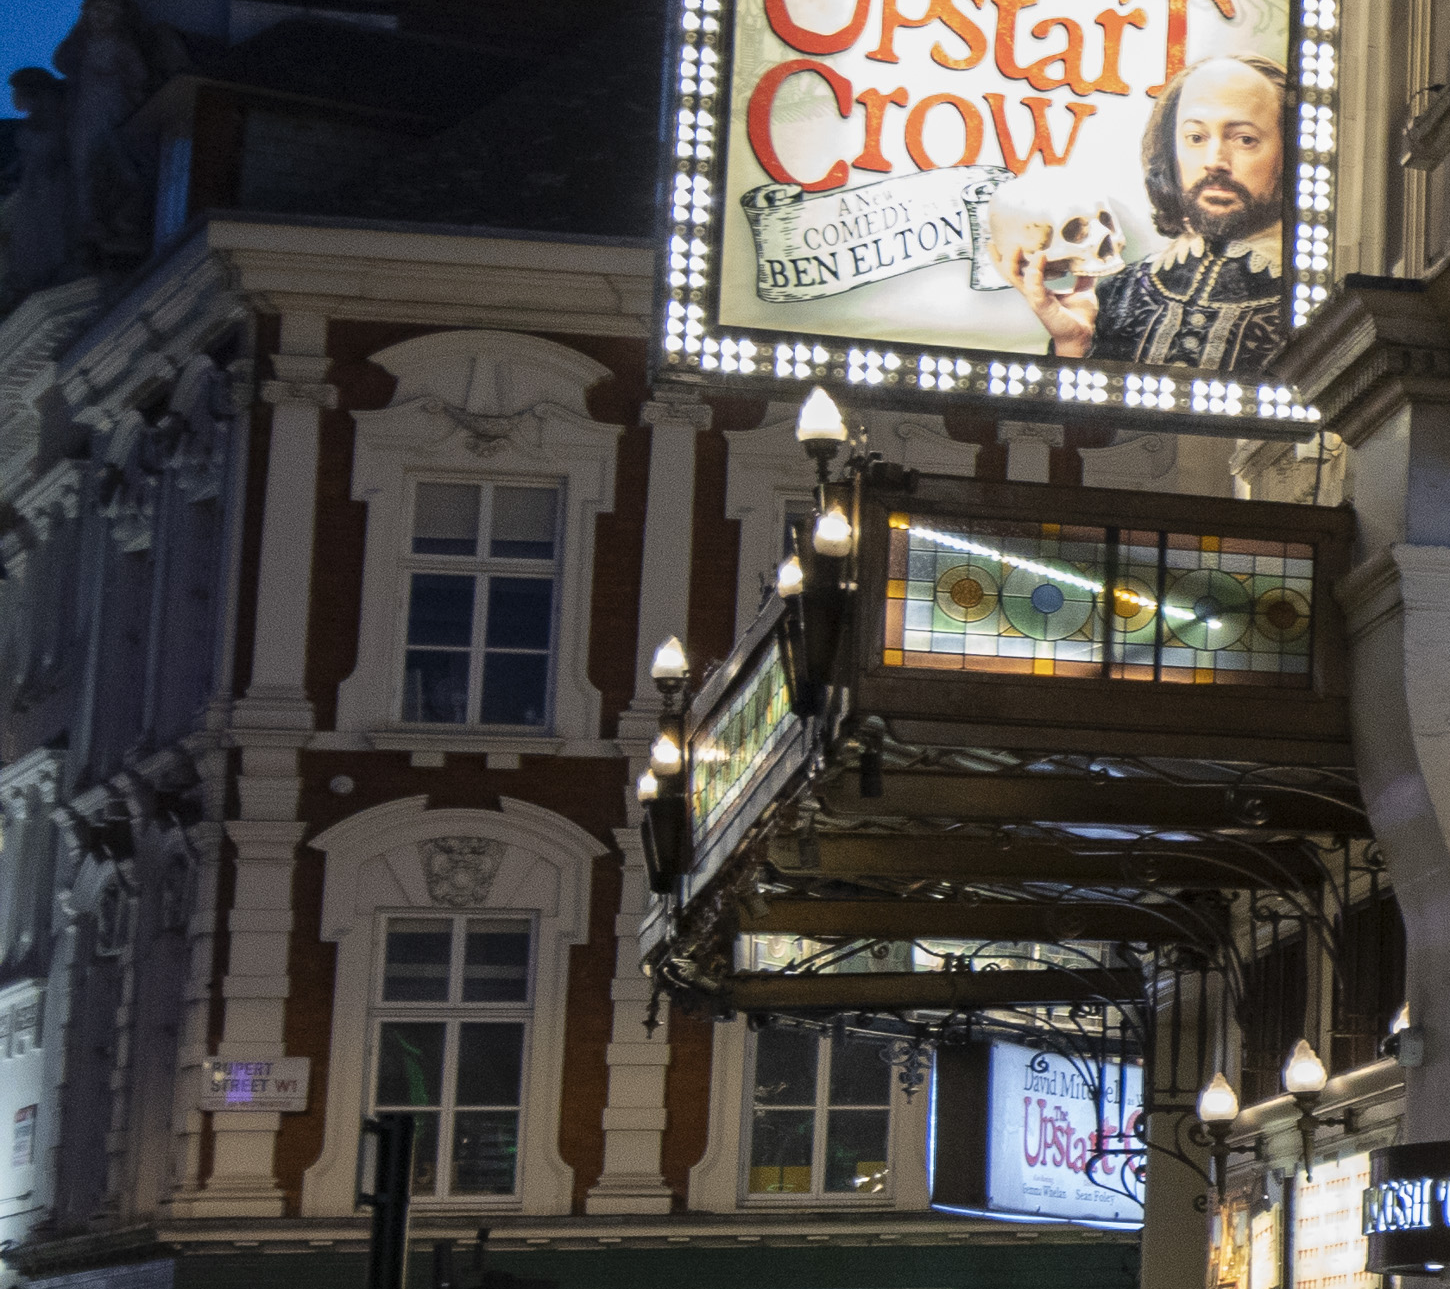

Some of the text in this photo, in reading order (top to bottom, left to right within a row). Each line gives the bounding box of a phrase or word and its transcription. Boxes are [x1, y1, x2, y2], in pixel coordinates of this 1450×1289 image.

[747, 58, 1098, 193] Crow
[766, 211, 964, 289] BEN ELTON
[803, 199, 912, 251] COMEDY
[211, 1078, 270, 1093] STREET
